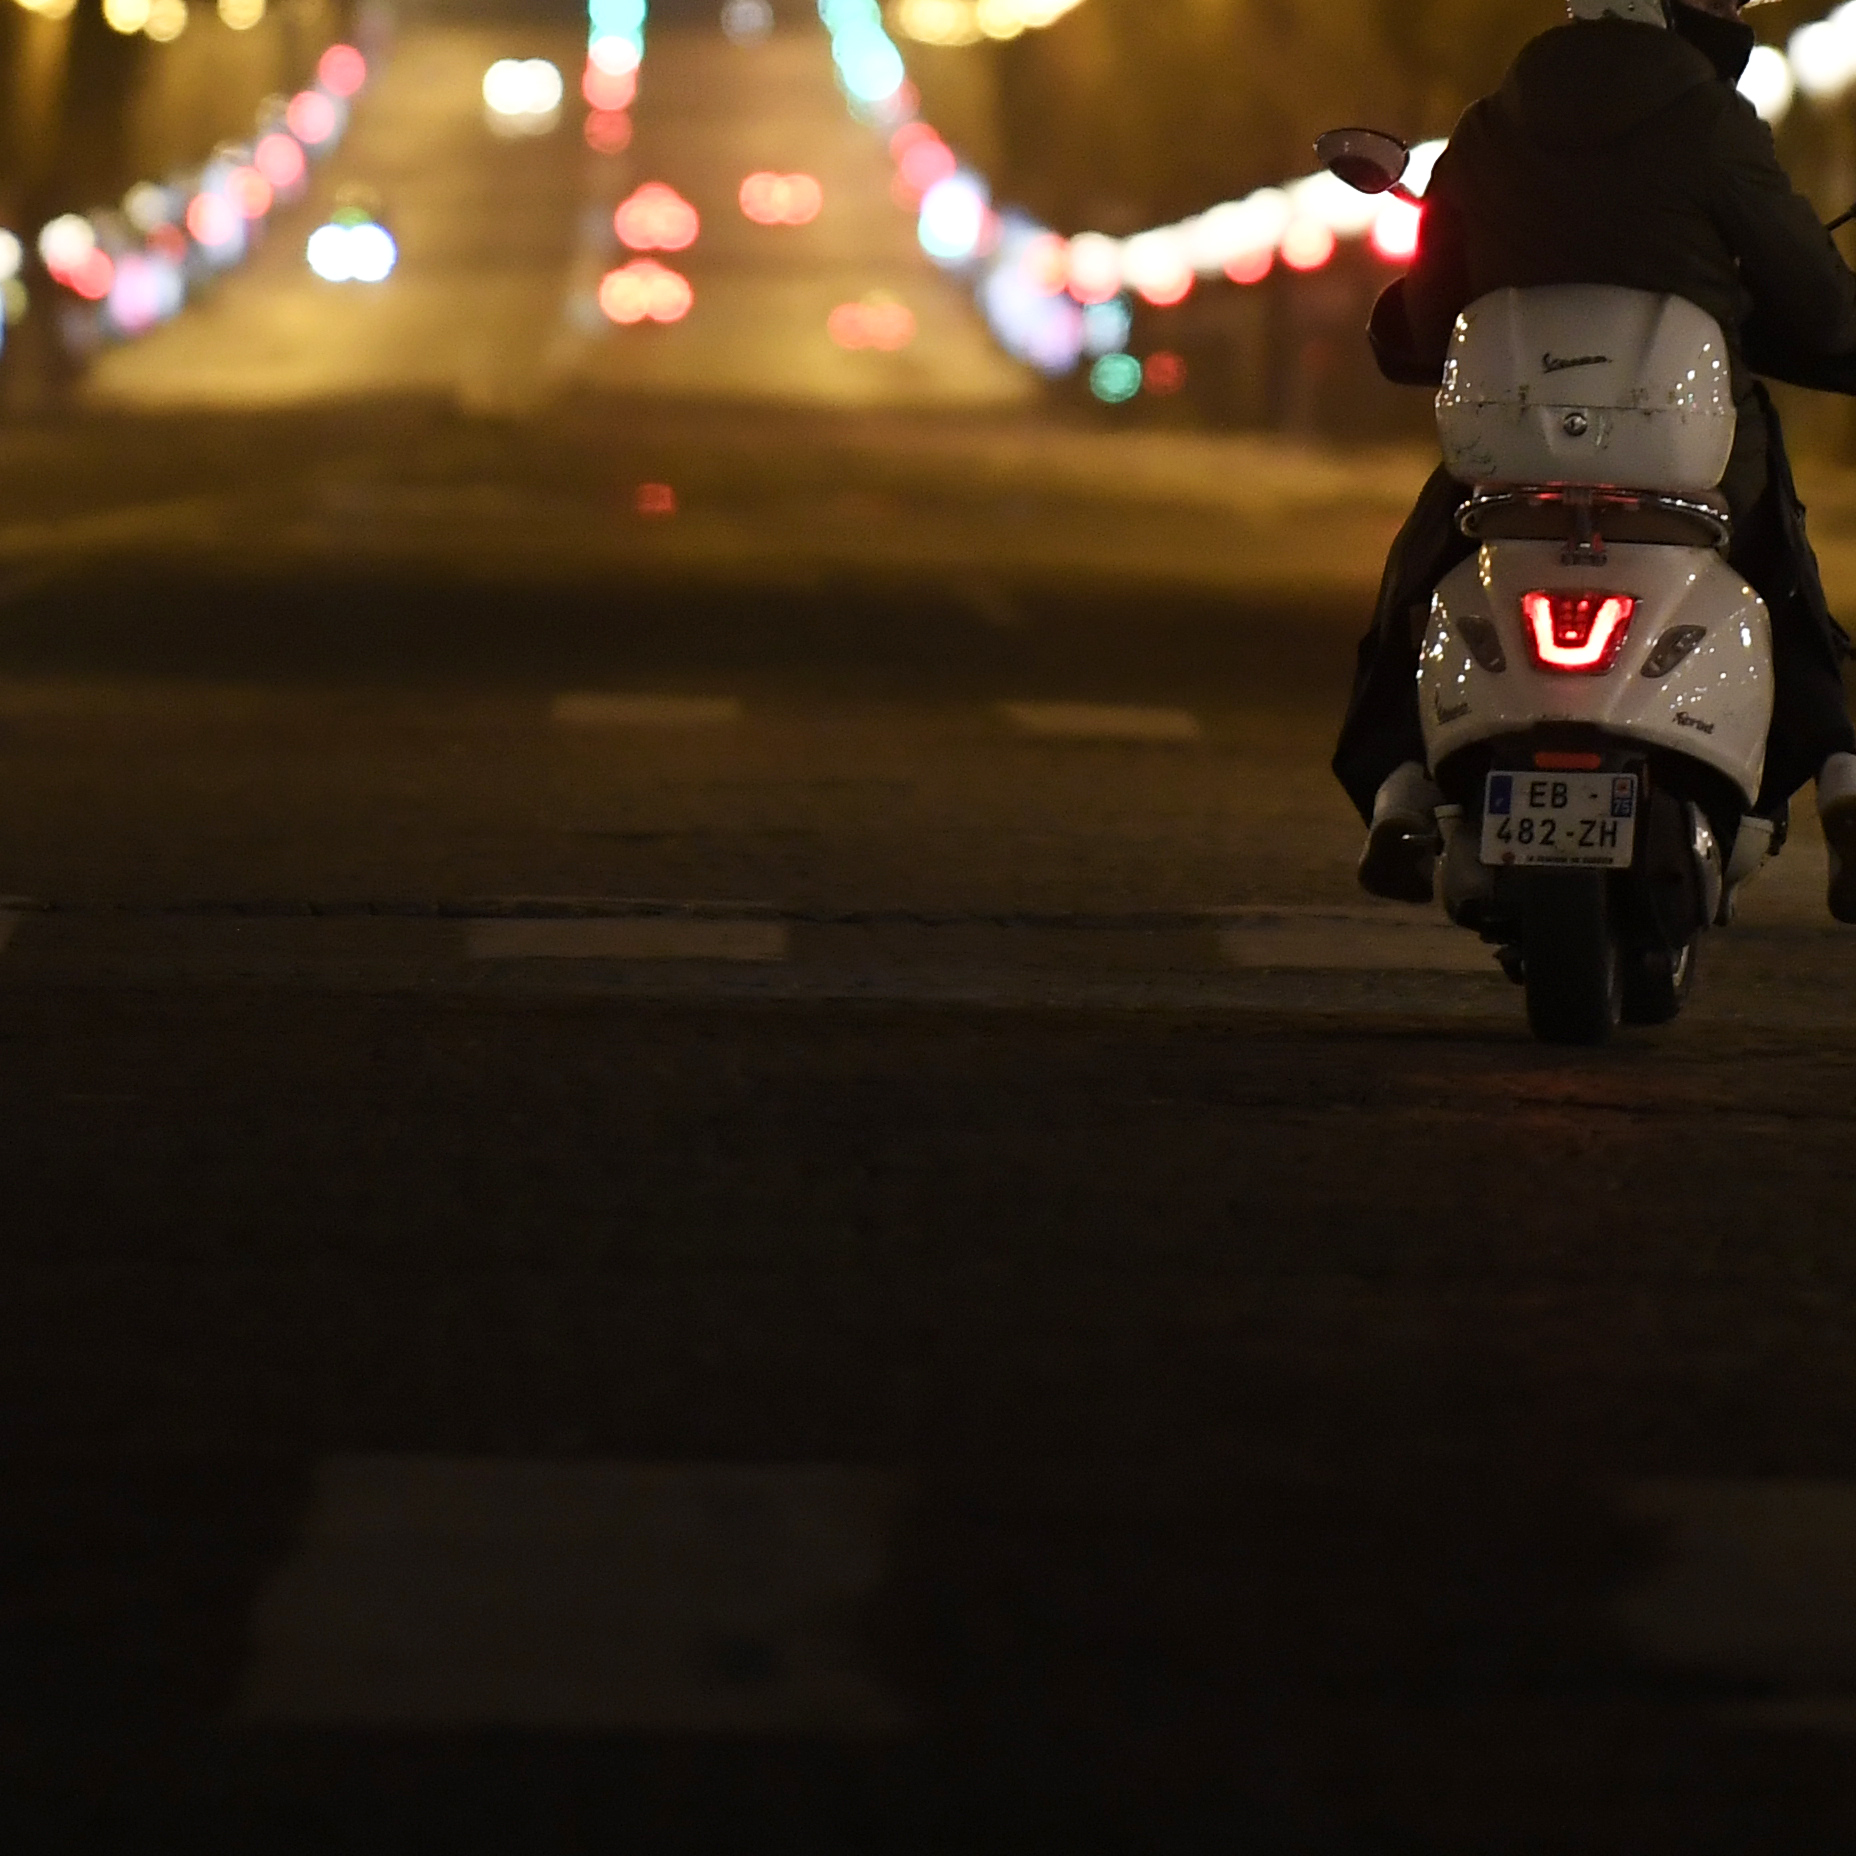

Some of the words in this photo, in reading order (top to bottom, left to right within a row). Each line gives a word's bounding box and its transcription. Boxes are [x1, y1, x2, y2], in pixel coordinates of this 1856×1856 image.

[1530, 781, 1567, 811] EB
[1612, 799, 1631, 814] 75
[1496, 818, 1617, 848] 482-ZH
